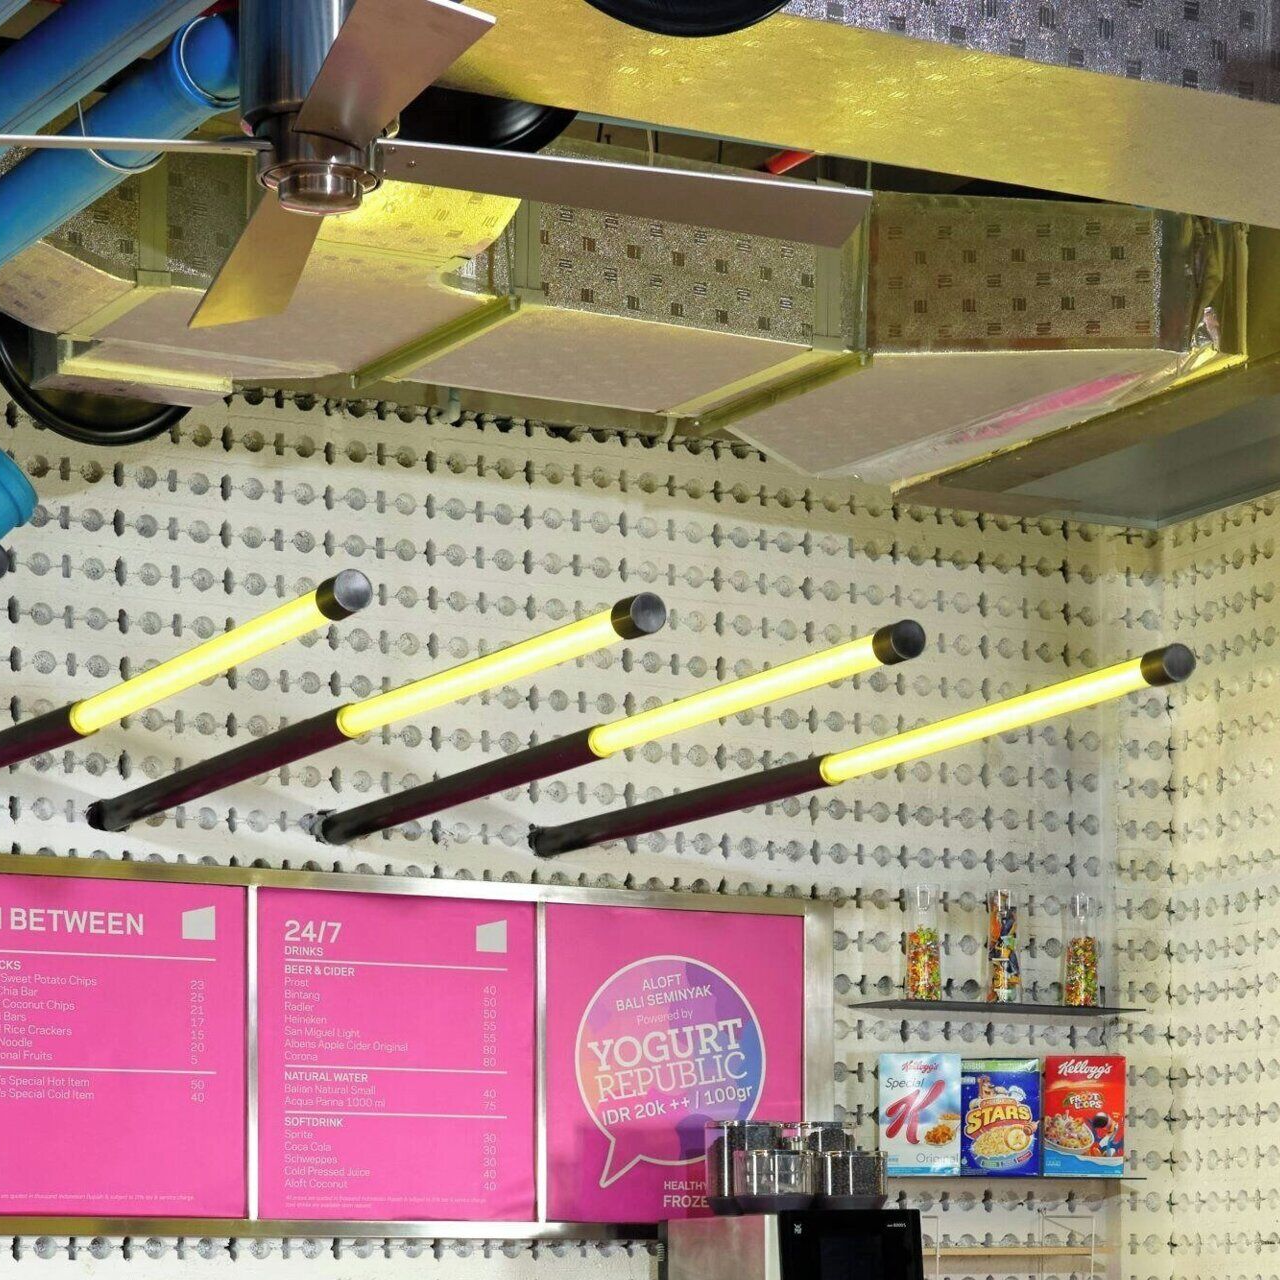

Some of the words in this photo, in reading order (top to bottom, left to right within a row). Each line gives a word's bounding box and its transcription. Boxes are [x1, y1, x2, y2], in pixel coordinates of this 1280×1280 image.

[11, 908, 143, 935] BETWEEN
[285, 920, 341, 943] 24/7
[285, 946, 323, 956] DRINKS
[285, 965, 312, 974] BEER
[314, 966, 321, 975] &
[324, 967, 354, 976] CIDER
[1, 973, 31, 983] Sweet
[34, 974, 66, 984] Potato
[68, 975, 97, 987] Chips
[643, 974, 681, 991] ALOFT
[21, 986, 38, 996] Bar
[190, 992, 204, 1003] 25
[285, 989, 320, 1002] Bintang
[617, 996, 645, 1012] BALI
[647, 985, 712, 1006] SEMINYAK
[2, 999, 44, 1009] Coconut
[46, 1000, 75, 1012] Chips
[285, 1001, 314, 1011] Radler
[4, 1011, 26, 1021] Bars
[636, 1009, 679, 1026] Powered
[681, 1009, 693, 1021] by
[4, 1024, 25, 1034] Rice
[28, 1025, 72, 1035] Crackers
[588, 1018, 743, 1072] YOGURT
[23, 1050, 52, 1060] Fruits
[285, 1051, 318, 1061] Corona
[902, 1061, 939, 1074] Kellogg's
[1058, 1059, 1111, 1079] Kellogg's
[9, 1076, 44, 1086] Special
[47, 1077, 65, 1086] Hot
[68, 1077, 89, 1087] Item
[191, 1079, 204, 1090] 50
[285, 1071, 332, 1081] NATURAL
[334, 1073, 368, 1082] WATER
[595, 1051, 747, 1103] REPUBLIC
[886, 1077, 925, 1089] Special
[9, 1088, 45, 1099] Special
[48, 1089, 70, 1099] Cold
[73, 1090, 94, 1099] Item
[191, 1093, 204, 1102] 40
[602, 1107, 631, 1125] IDR
[634, 1100, 666, 1119] 20k
[704, 1086, 752, 1105] 100gr
[886, 1080, 946, 1144] K
[285, 1117, 343, 1127] SOFTDRINK
[966, 1104, 1032, 1130] STARS
[285, 1129, 313, 1140] Sprite
[916, 1152, 959, 1164] Original
[664, 1195, 709, 1208] FROZE
